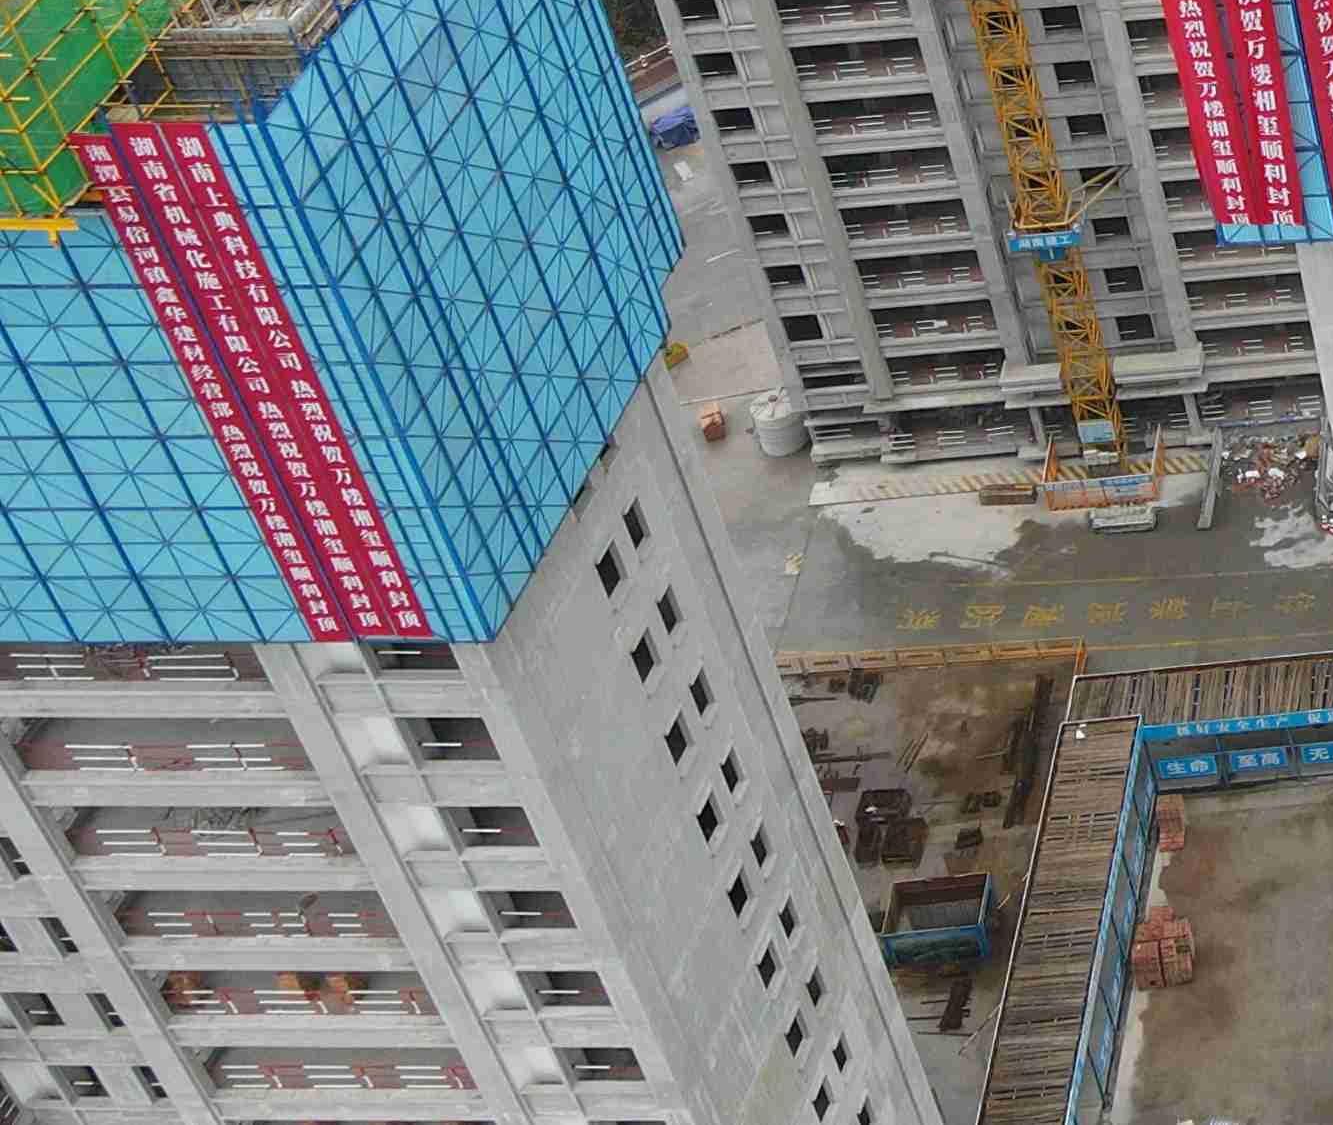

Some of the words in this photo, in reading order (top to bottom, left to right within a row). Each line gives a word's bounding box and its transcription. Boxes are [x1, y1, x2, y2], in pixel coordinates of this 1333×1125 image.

[1179, 0, 1250, 225] 热烈祝贺万楼湘玺顺利封顶
[128, 136, 270, 394] 湖南省机械化施工有限公司
[1167, 759, 1209, 775] 生命
[1239, 753, 1282, 768] 至高
